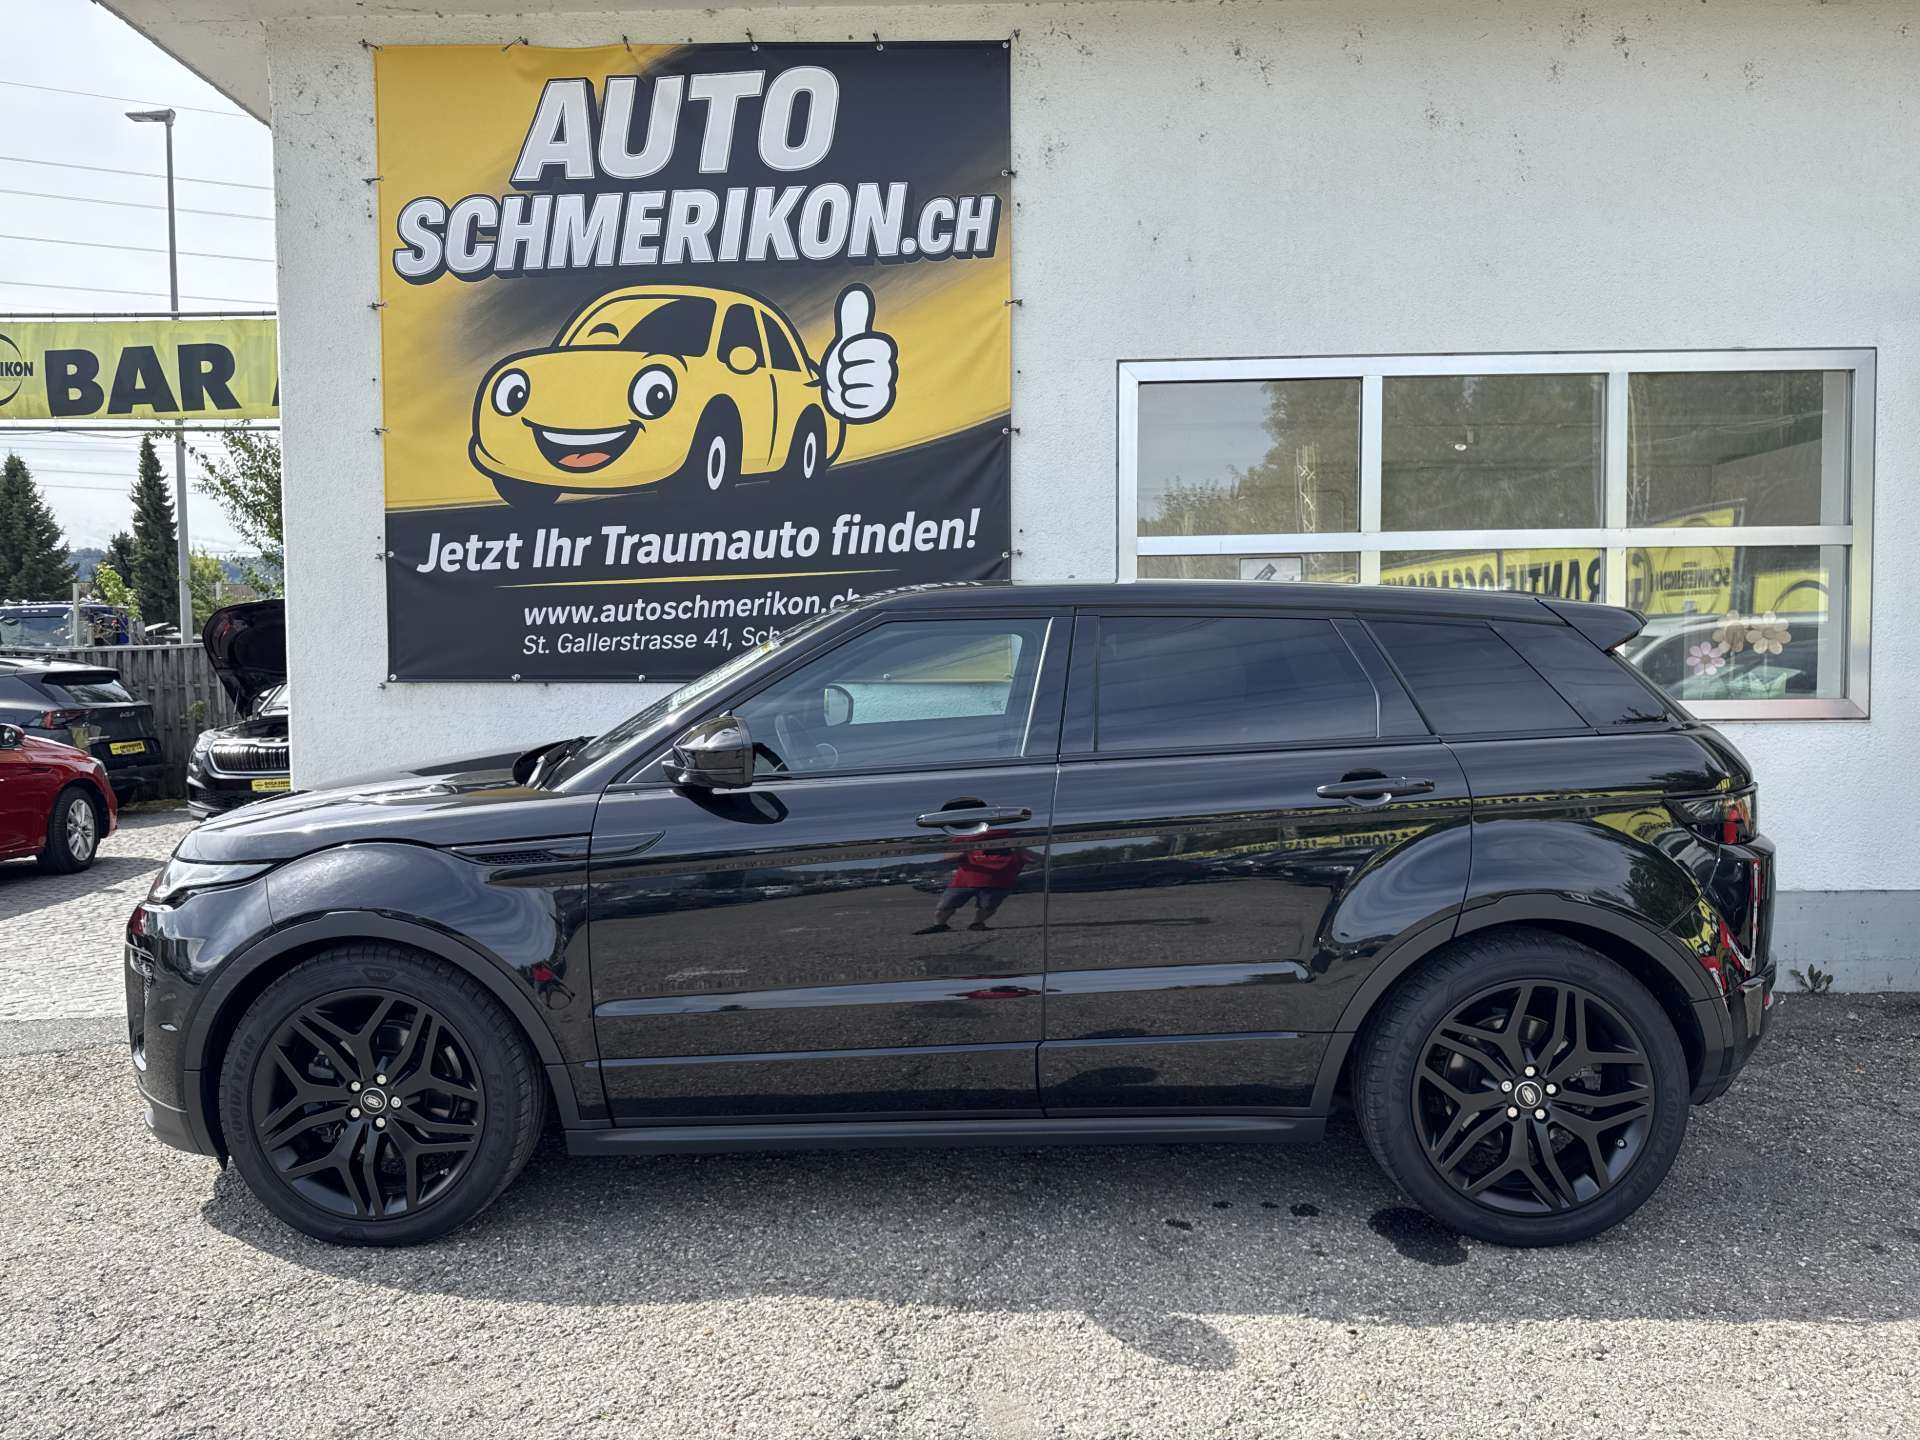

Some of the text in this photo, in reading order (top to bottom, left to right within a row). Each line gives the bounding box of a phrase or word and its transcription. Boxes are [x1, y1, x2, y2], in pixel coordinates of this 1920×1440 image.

[511, 65, 839, 182] AUTO
[394, 181, 997, 277] SCHMERIKON.CH
[44, 342, 242, 417] BAR
[416, 508, 980, 573] Jetzt Ihr Traumauto finden!
[523, 635, 549, 655] St.
[557, 631, 697, 654] Gallerstrasse
[704, 627, 732, 651] 41,
